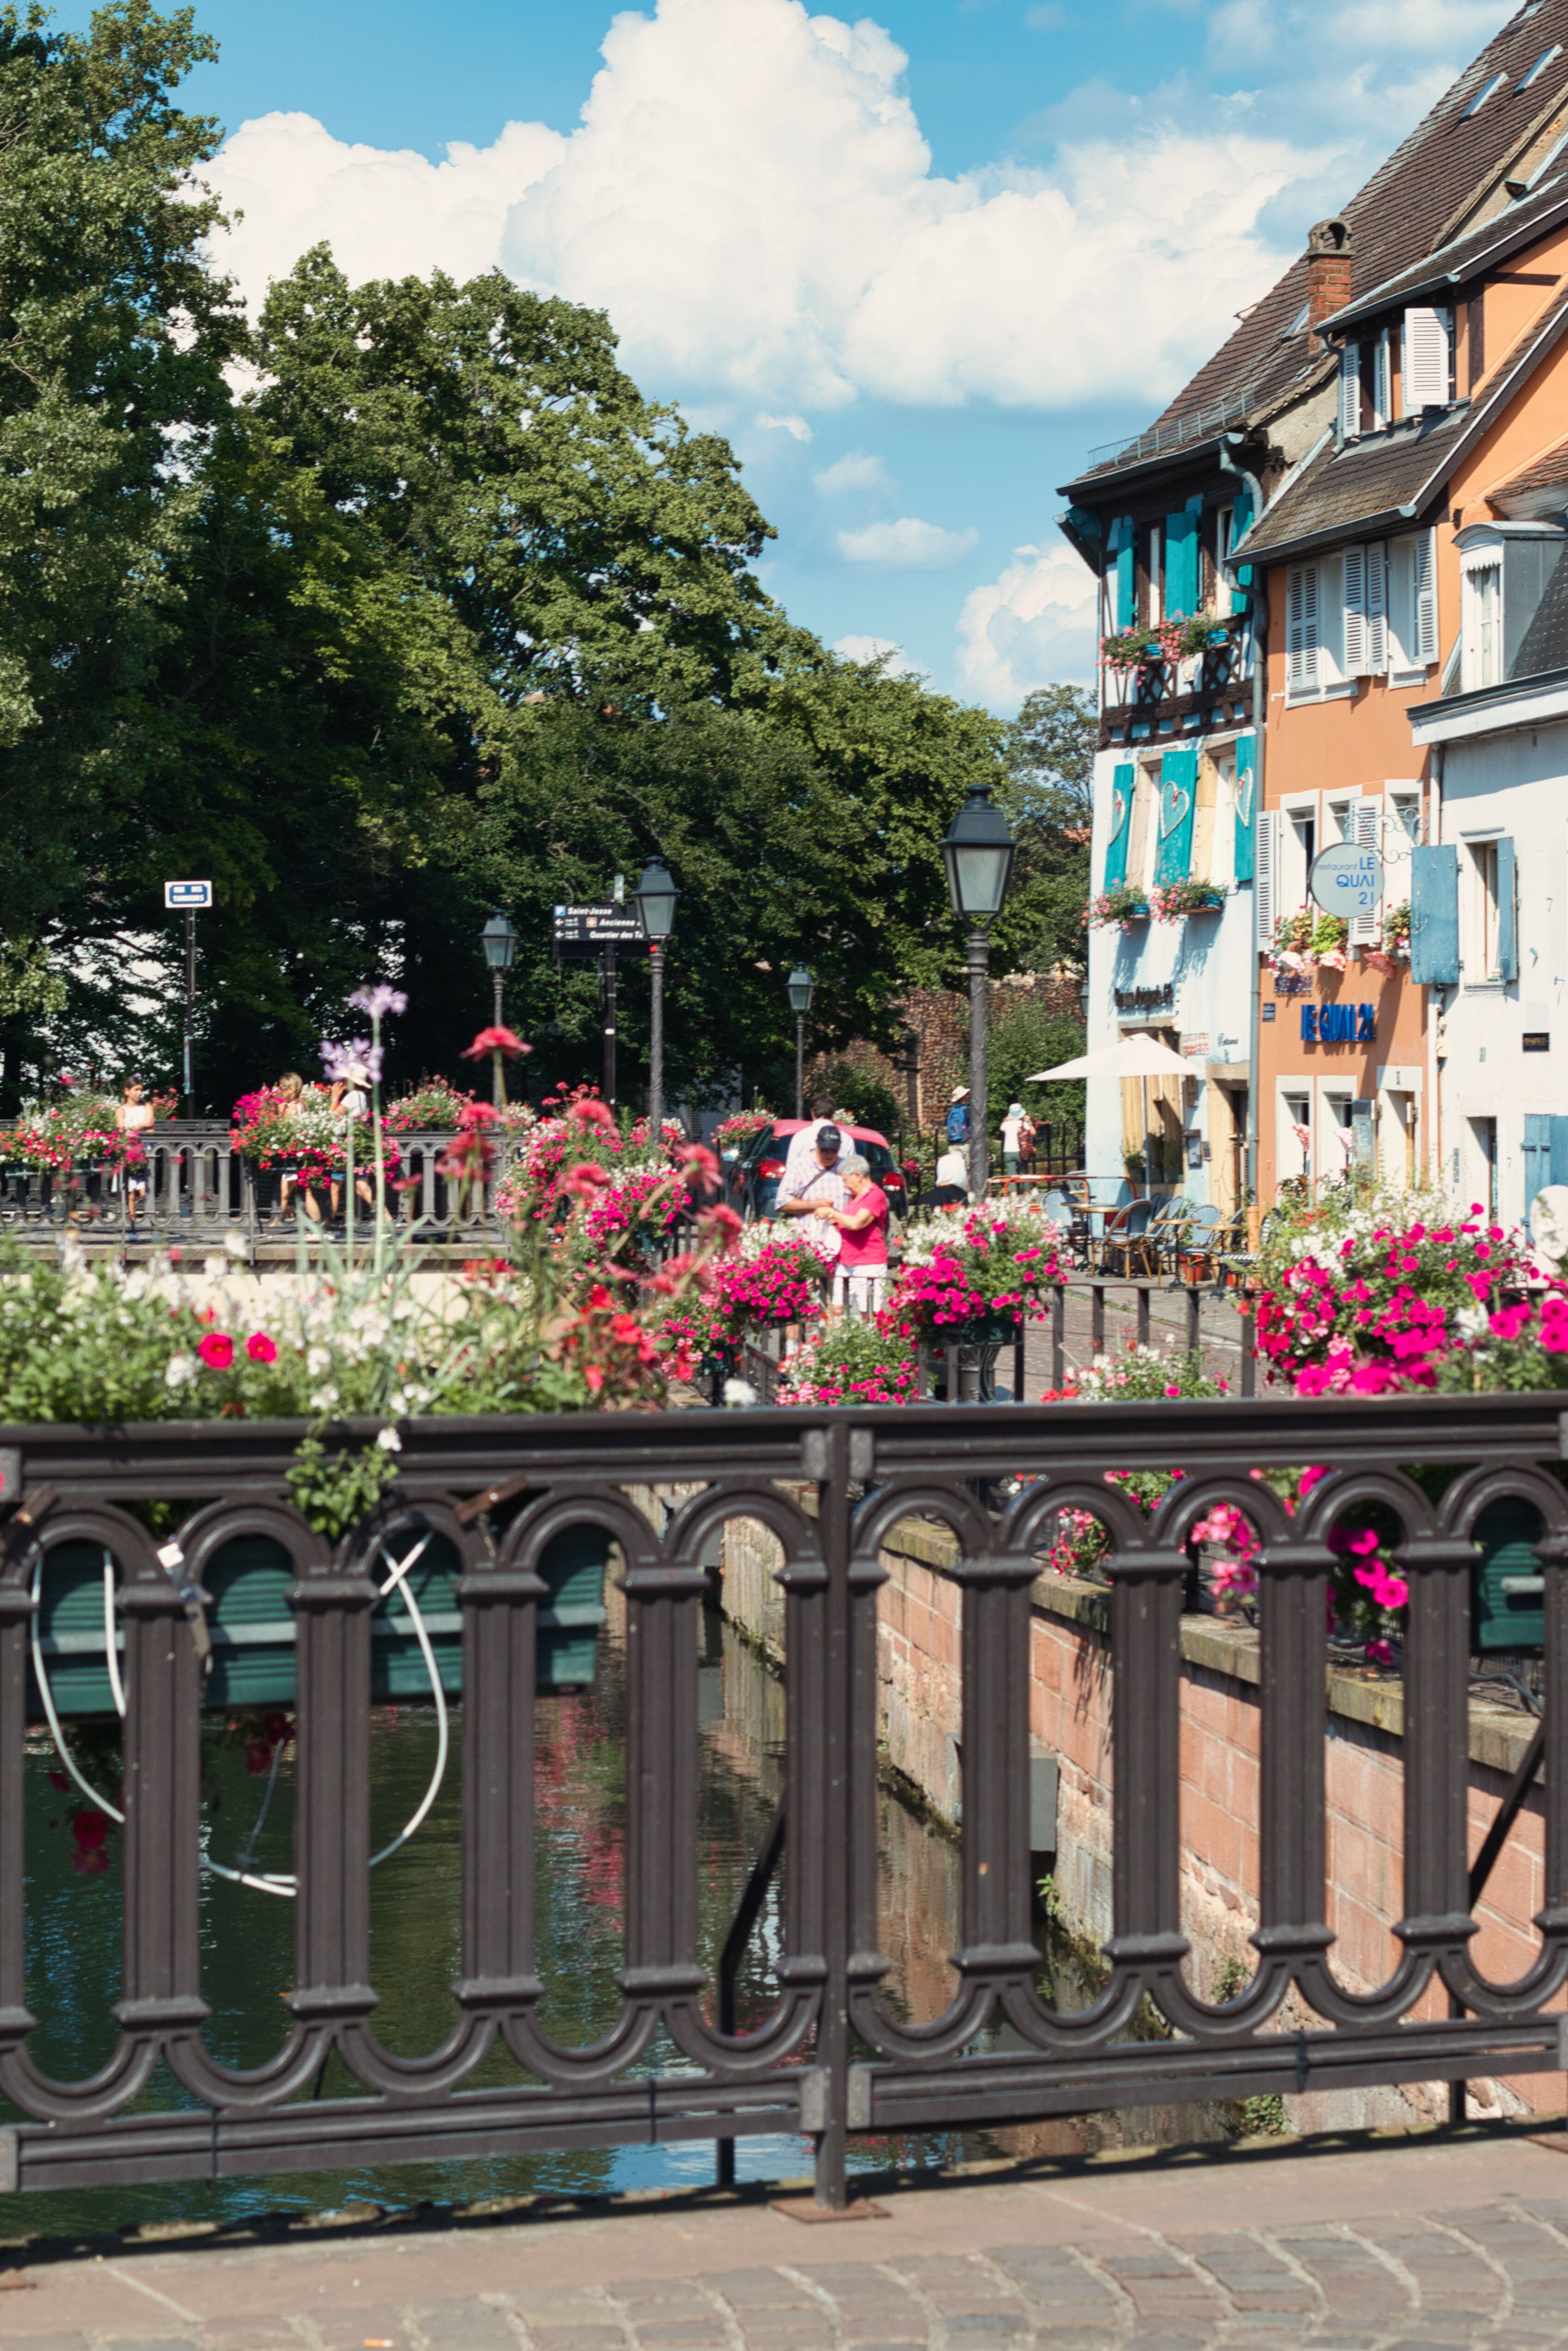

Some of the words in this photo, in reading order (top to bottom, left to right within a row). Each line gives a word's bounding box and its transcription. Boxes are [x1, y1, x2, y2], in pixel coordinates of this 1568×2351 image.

[1359, 857, 1375, 870] LE
[1335, 874, 1375, 888] QUAI
[1358, 891, 1374, 905] 21
[589, 931, 620, 939] Quartier
[620, 931, 634, 939] des
[1319, 1003, 1356, 1042] QUAI
